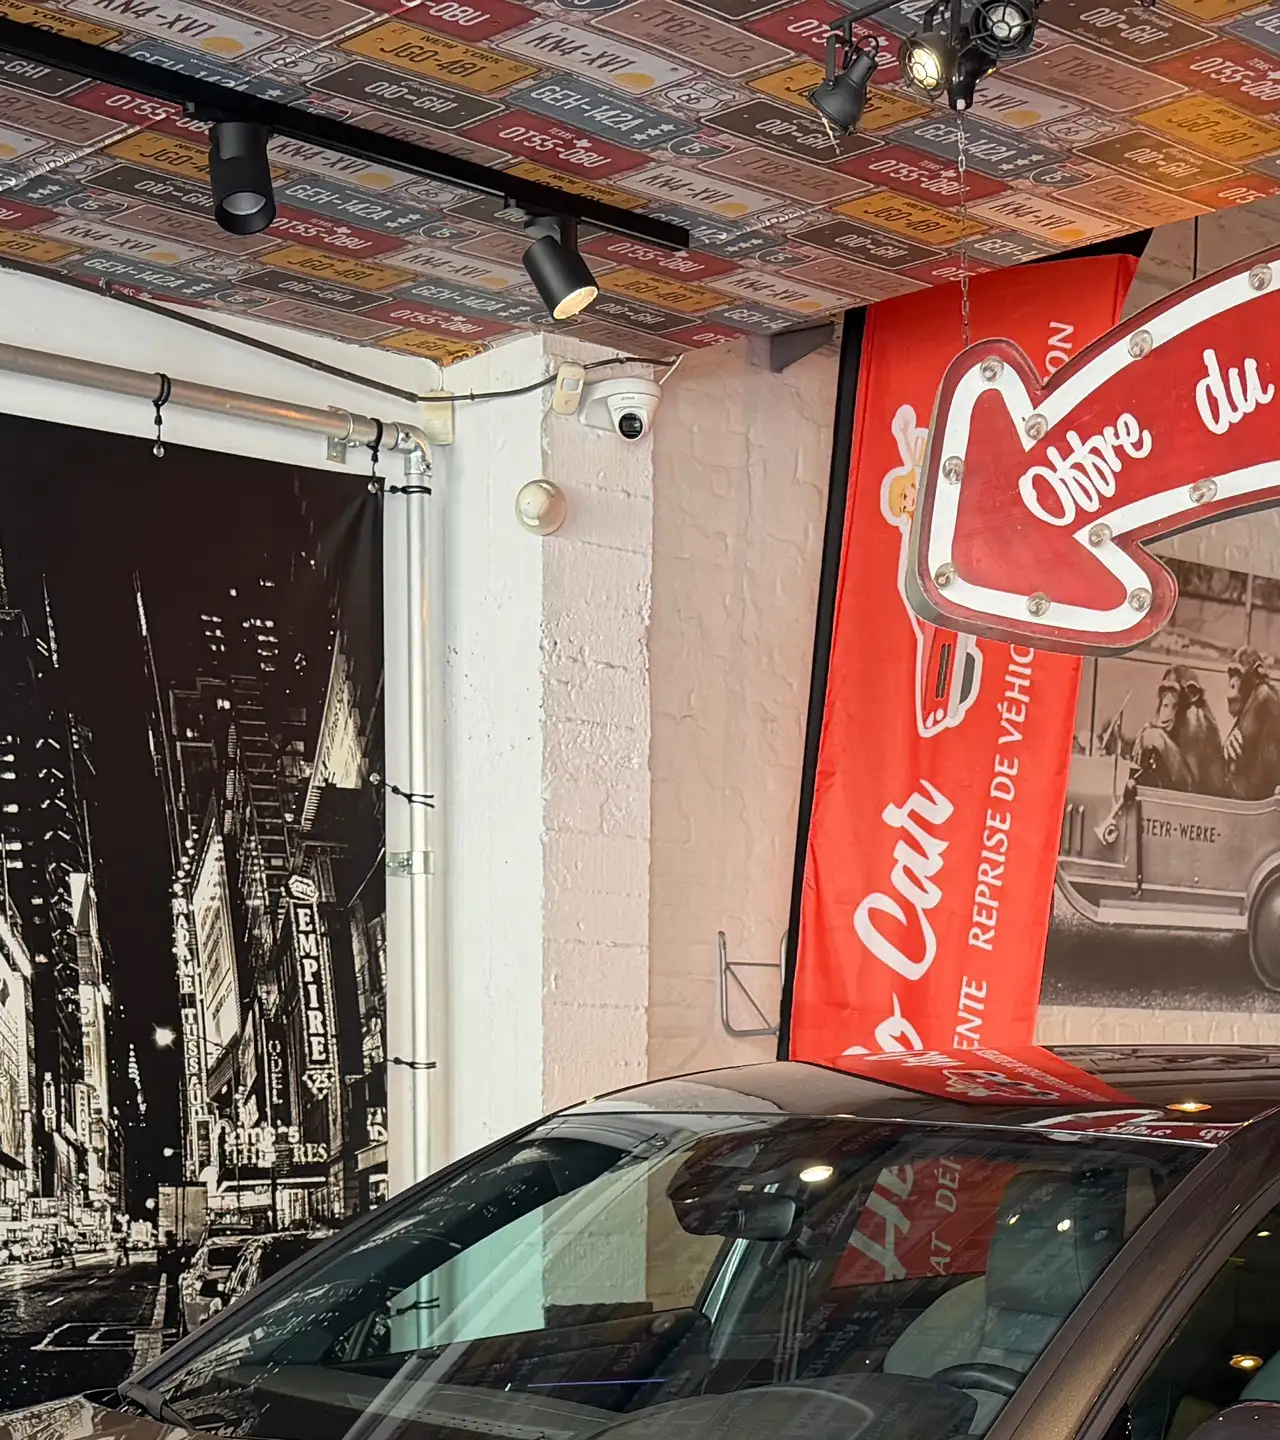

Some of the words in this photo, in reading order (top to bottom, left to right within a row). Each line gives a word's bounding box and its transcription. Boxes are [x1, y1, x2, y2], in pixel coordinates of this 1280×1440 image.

[379, 42, 487, 78] JGO-481
[420, 35, 458, 49] NEW
[530, 86, 645, 131] GEH-142A
[680, 141, 702, 154] 15
[1019, 411, 1154, 529] Offre
[1195, 349, 1276, 436] du
[989, 752, 1020, 802] DE
[853, 779, 956, 982] Car
[968, 808, 1011, 951] REPRISE
[296, 907, 327, 1062] EMPIRE
